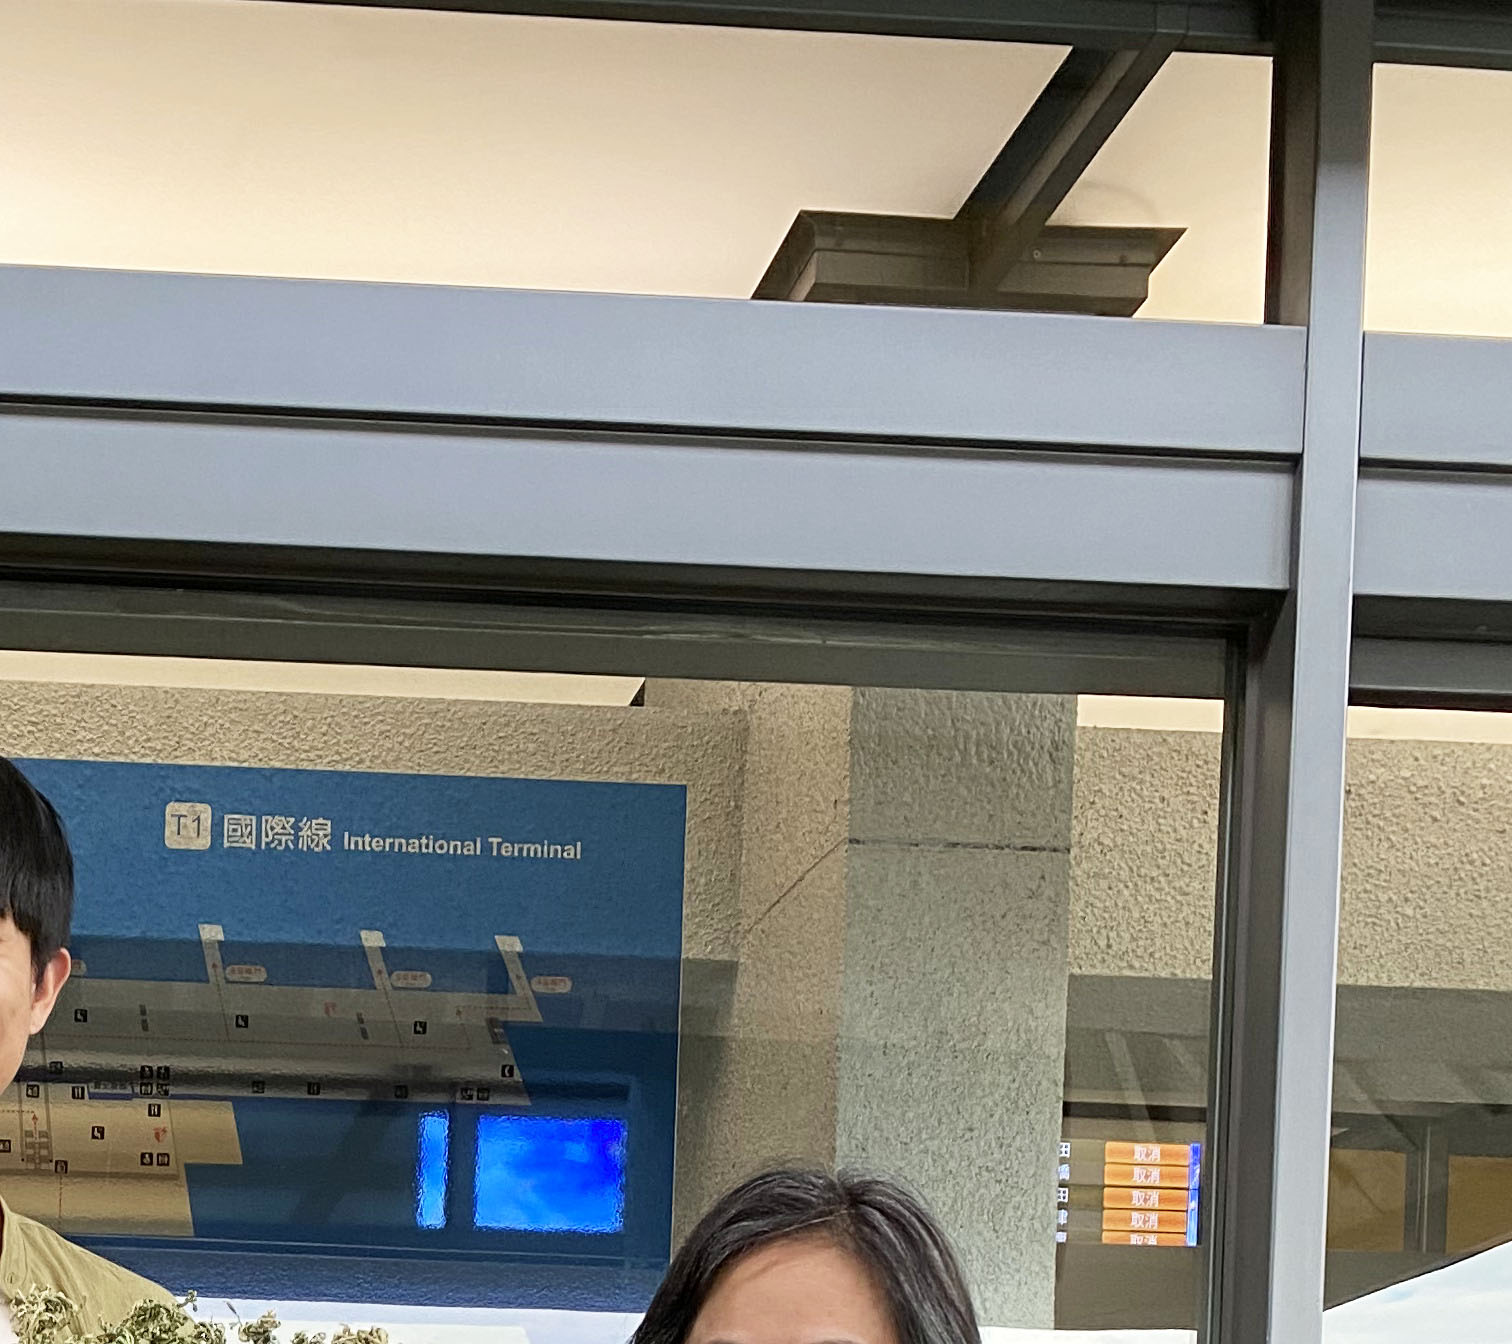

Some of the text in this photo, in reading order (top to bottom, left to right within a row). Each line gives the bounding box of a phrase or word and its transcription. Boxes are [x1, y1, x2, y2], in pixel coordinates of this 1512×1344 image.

[170, 812, 583, 860] T1 國際線 International Terminal
[1133, 1144, 1160, 1162] 取消
[1133, 1168, 1160, 1184] 取消
[1131, 1190, 1159, 1207] 取消
[1131, 1211, 1159, 1229] 取消
